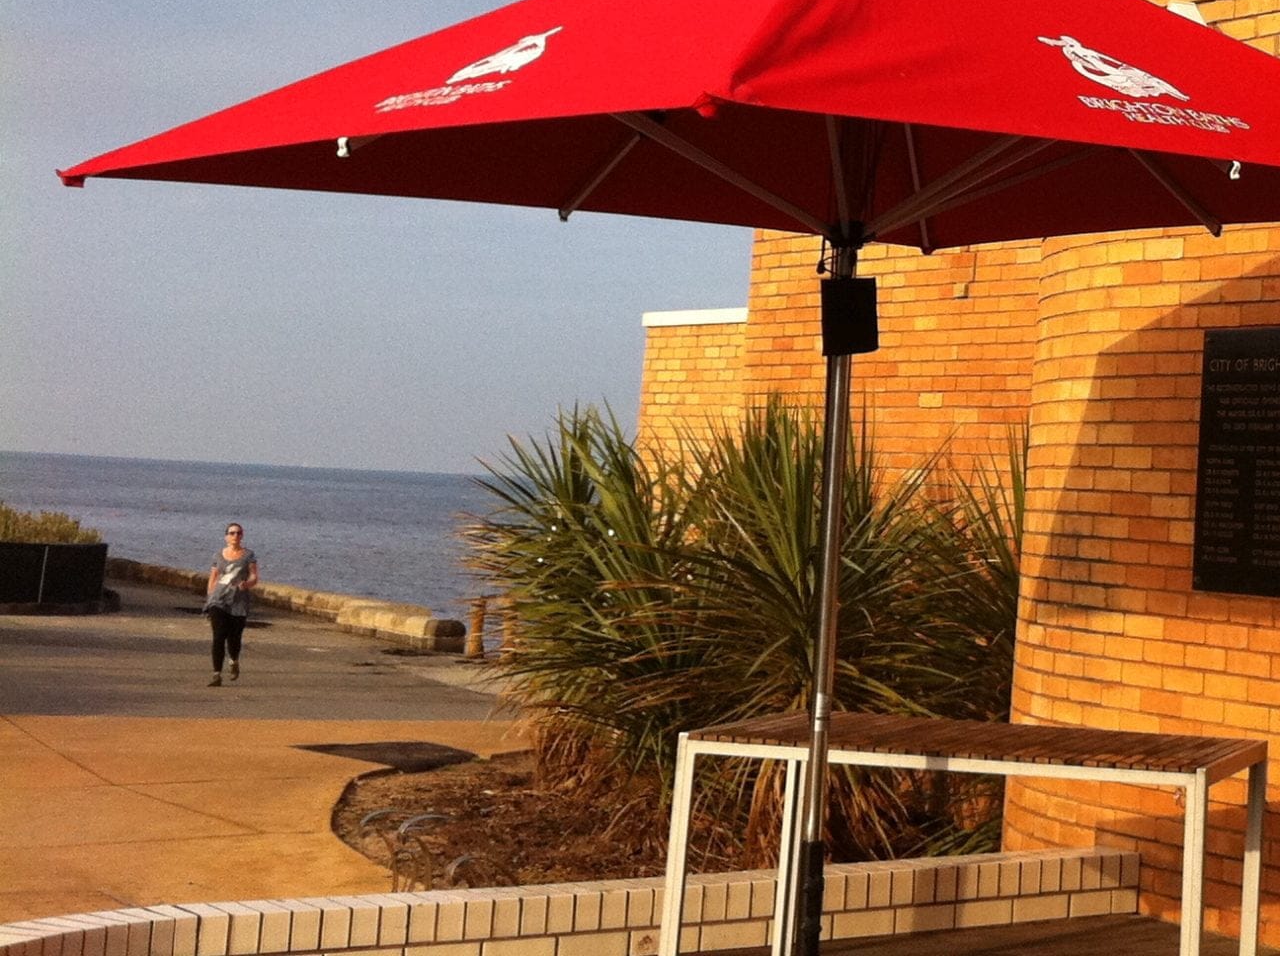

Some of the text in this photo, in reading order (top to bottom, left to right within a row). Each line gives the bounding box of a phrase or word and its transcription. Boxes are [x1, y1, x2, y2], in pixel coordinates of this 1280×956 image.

[1077, 96, 1250, 130] BRIGHTON BATHS
[1123, 111, 1189, 126] HEALTH
[1209, 359, 1231, 372] CITY
[1235, 358, 1249, 371] OF
